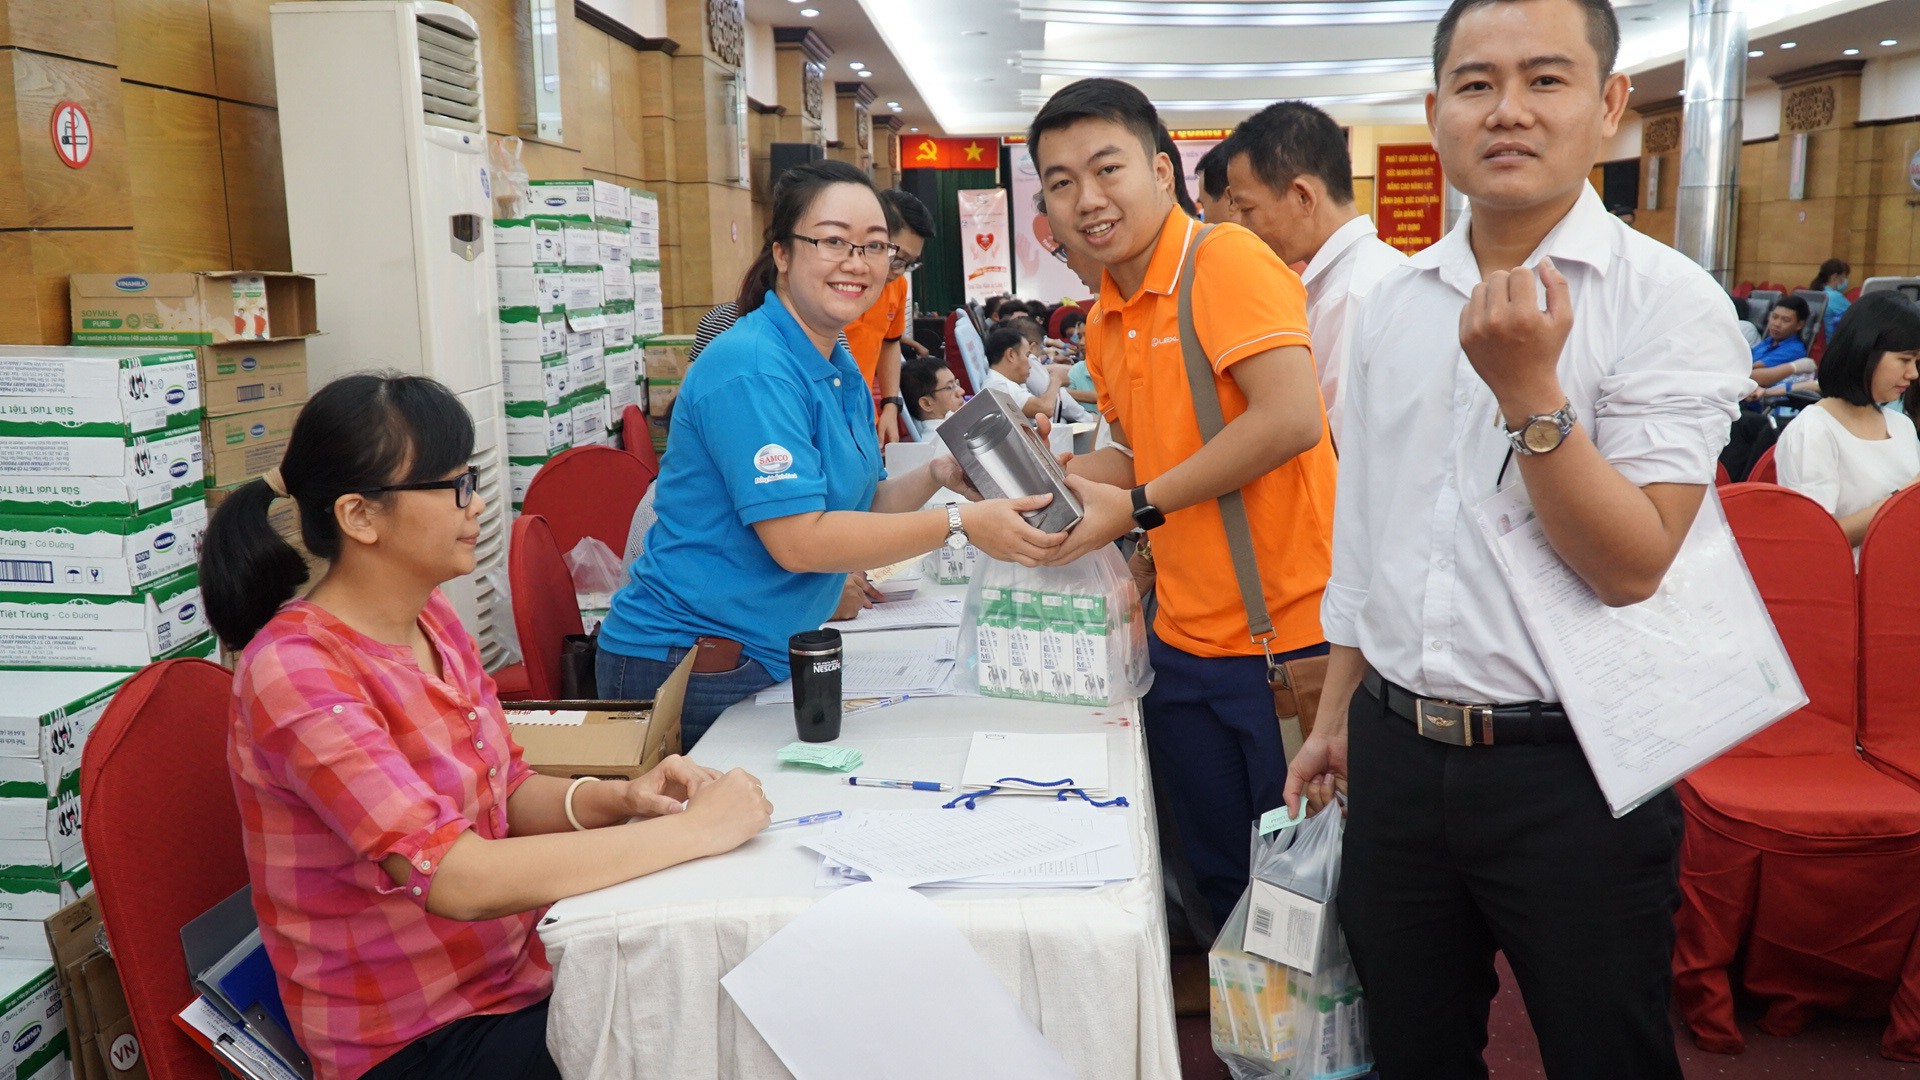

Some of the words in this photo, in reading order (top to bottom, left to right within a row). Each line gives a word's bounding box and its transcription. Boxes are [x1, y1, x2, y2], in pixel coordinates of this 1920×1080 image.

[9, 405, 27, 414] Tiệt
[30, 406, 52, 414] Tươi
[55, 407, 74, 415] Sữa
[759, 454, 789, 465] SAMCO
[16, 484, 34, 494] Tiệt
[37, 486, 58, 494] Tươi
[61, 486, 80, 495] Sữa
[155, 535, 175, 547] VINAMILK
[14, 1026, 41, 1050] VINAMILK
[113, 1041, 135, 1063] VN
